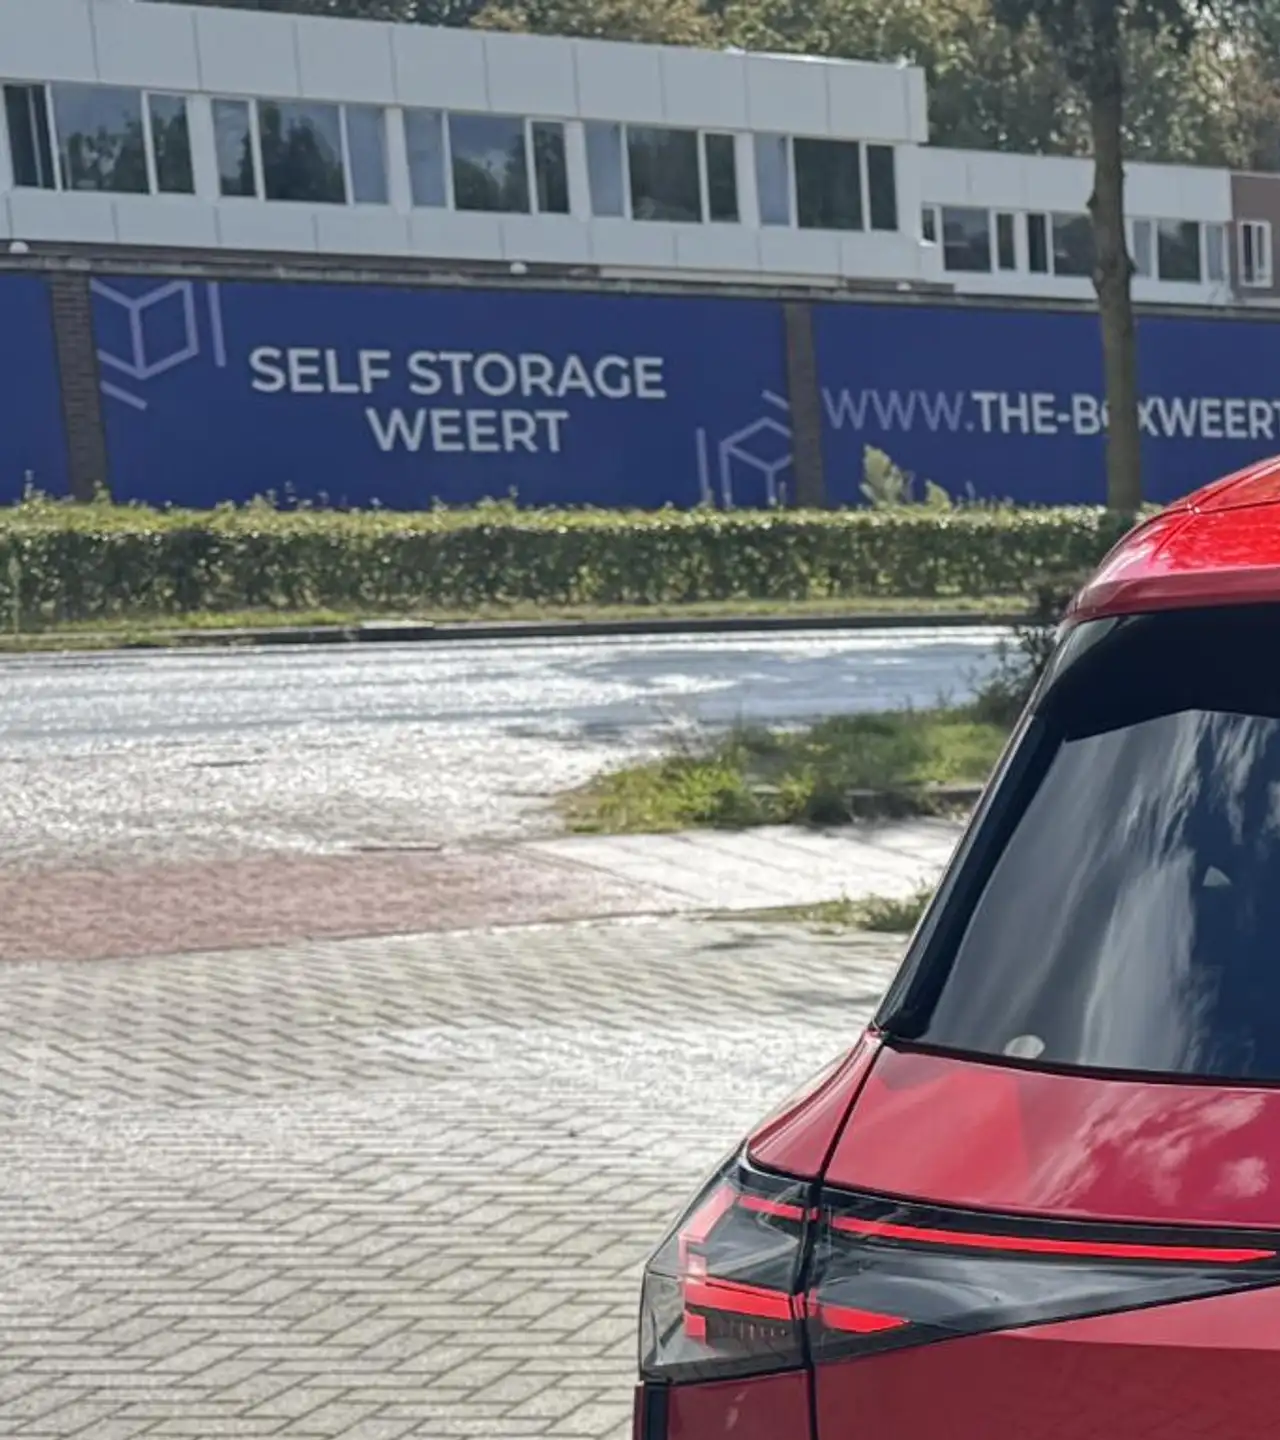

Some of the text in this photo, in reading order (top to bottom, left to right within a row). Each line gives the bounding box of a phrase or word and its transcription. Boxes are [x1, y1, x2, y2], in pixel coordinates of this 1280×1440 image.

[249, 346, 667, 399] SELF STORAGE
[365, 406, 570, 454] WEERT
